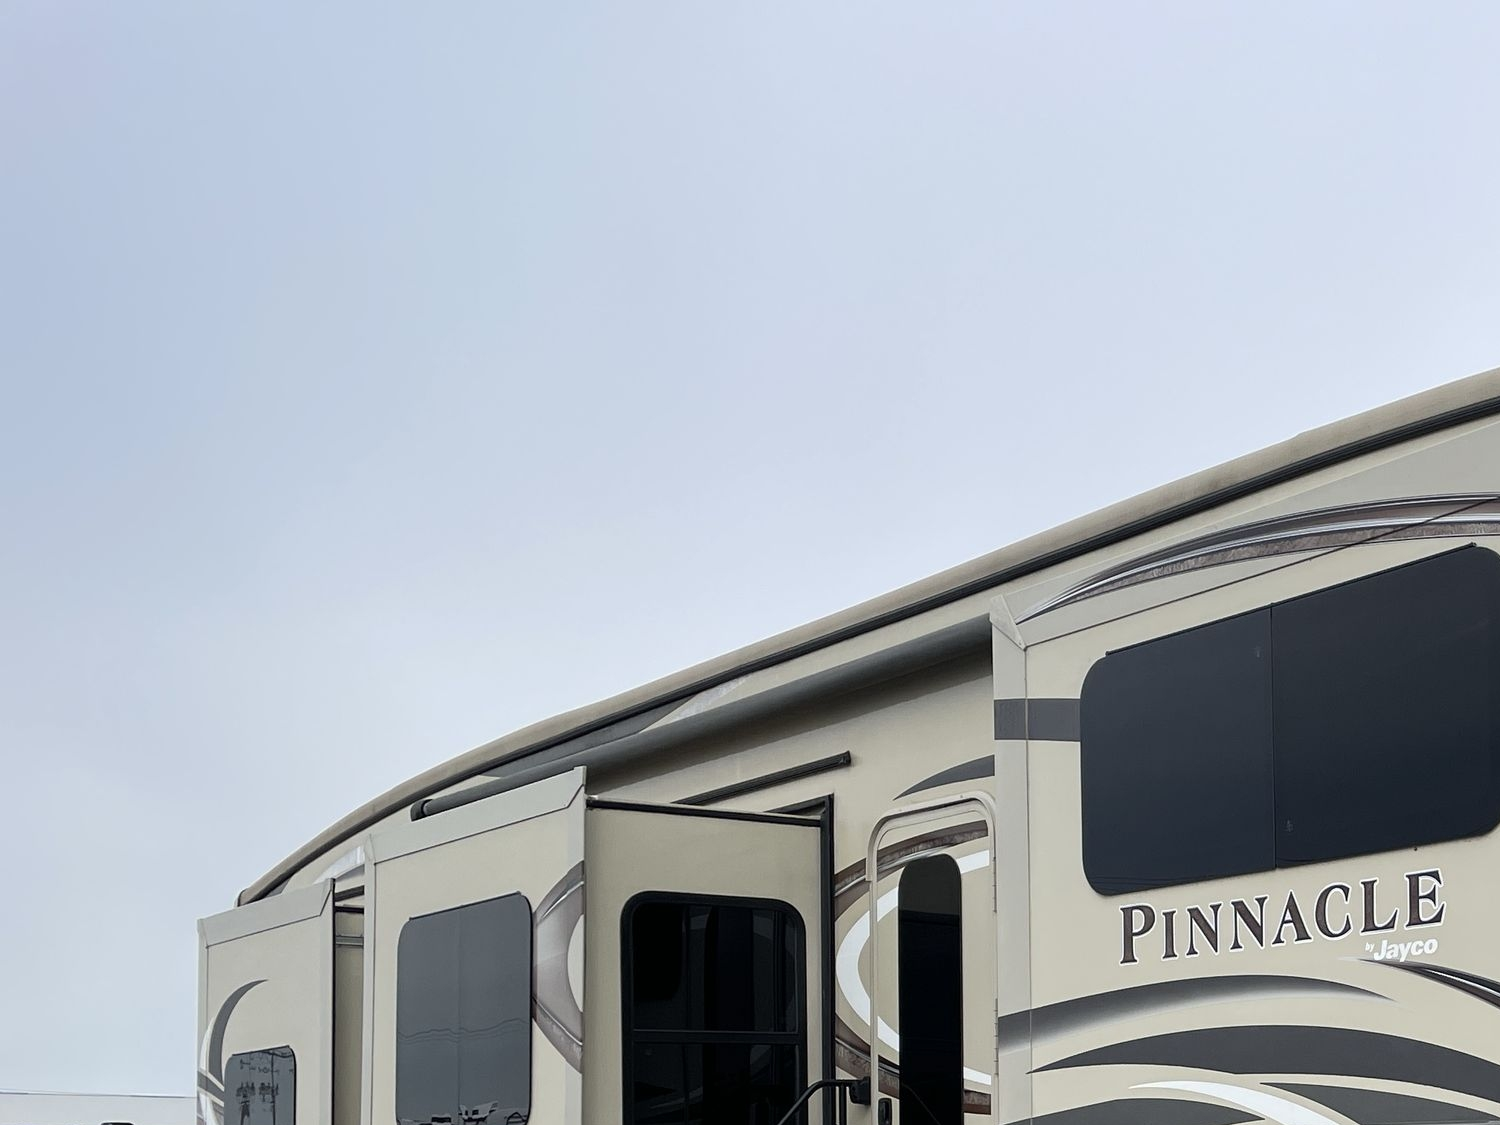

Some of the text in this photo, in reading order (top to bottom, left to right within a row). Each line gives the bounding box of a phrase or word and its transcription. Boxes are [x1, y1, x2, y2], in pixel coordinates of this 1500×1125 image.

[1119, 867, 1447, 965] PINNACLE
[1364, 938, 1439, 963] by Jayco
